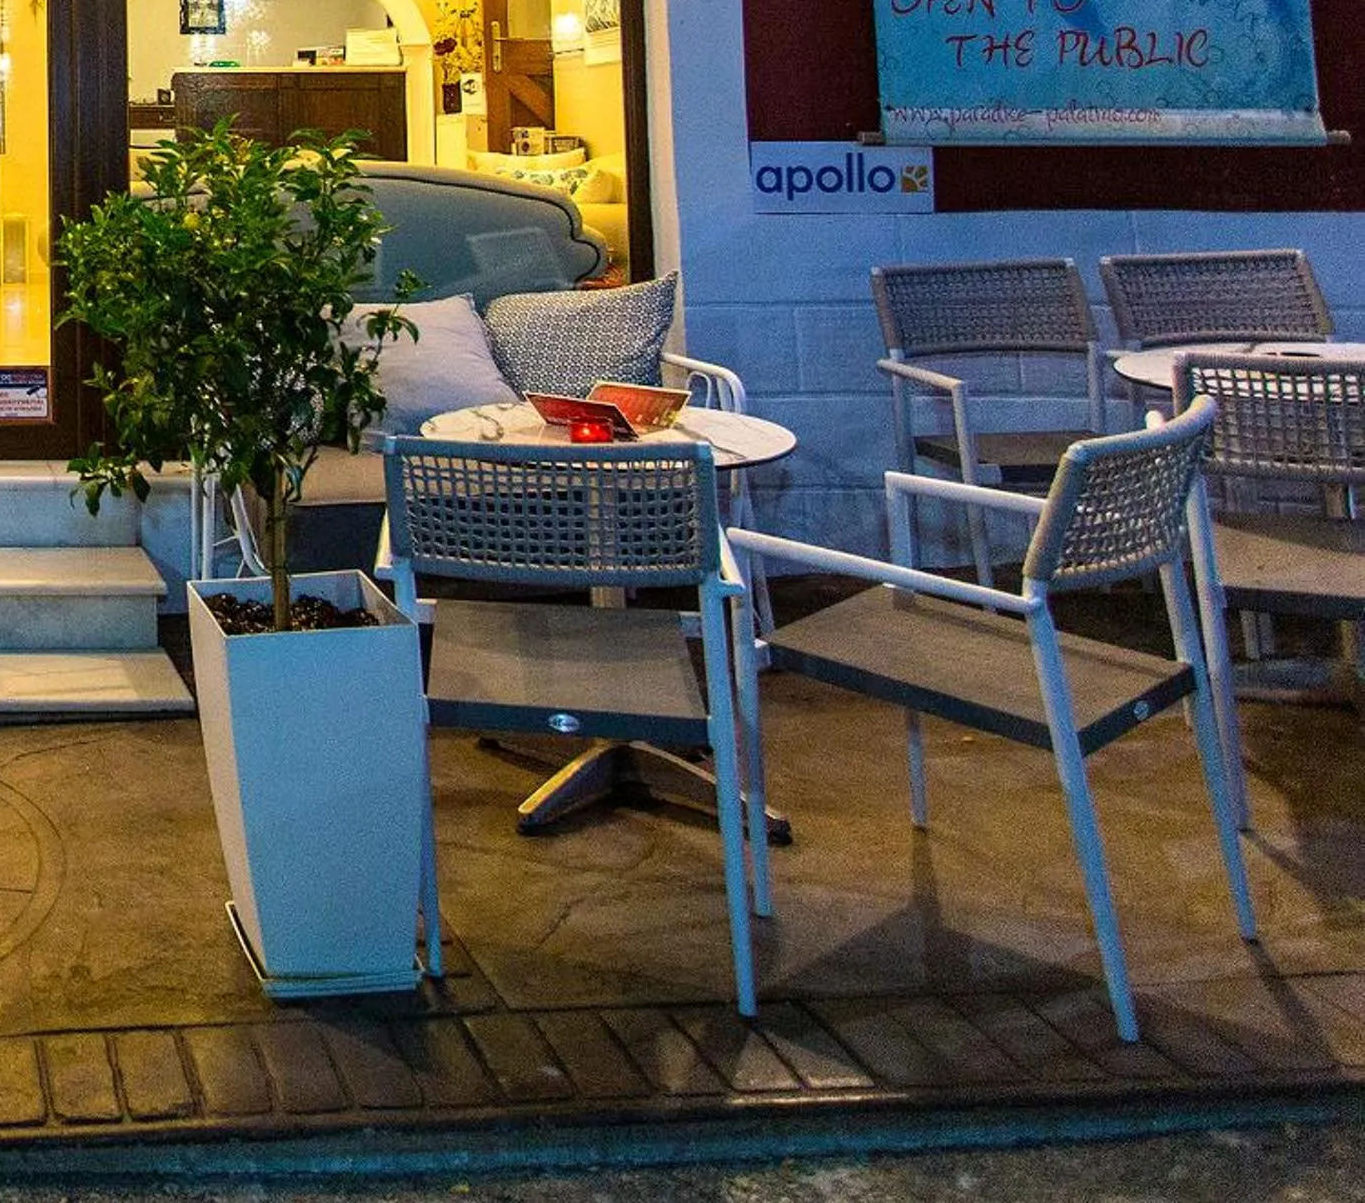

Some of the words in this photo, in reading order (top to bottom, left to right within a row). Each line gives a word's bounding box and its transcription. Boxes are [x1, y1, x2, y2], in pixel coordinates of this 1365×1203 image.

[945, 29, 1036, 68] THE
[1056, 25, 1210, 68] PUBLIC
[756, 152, 896, 201] apollo
